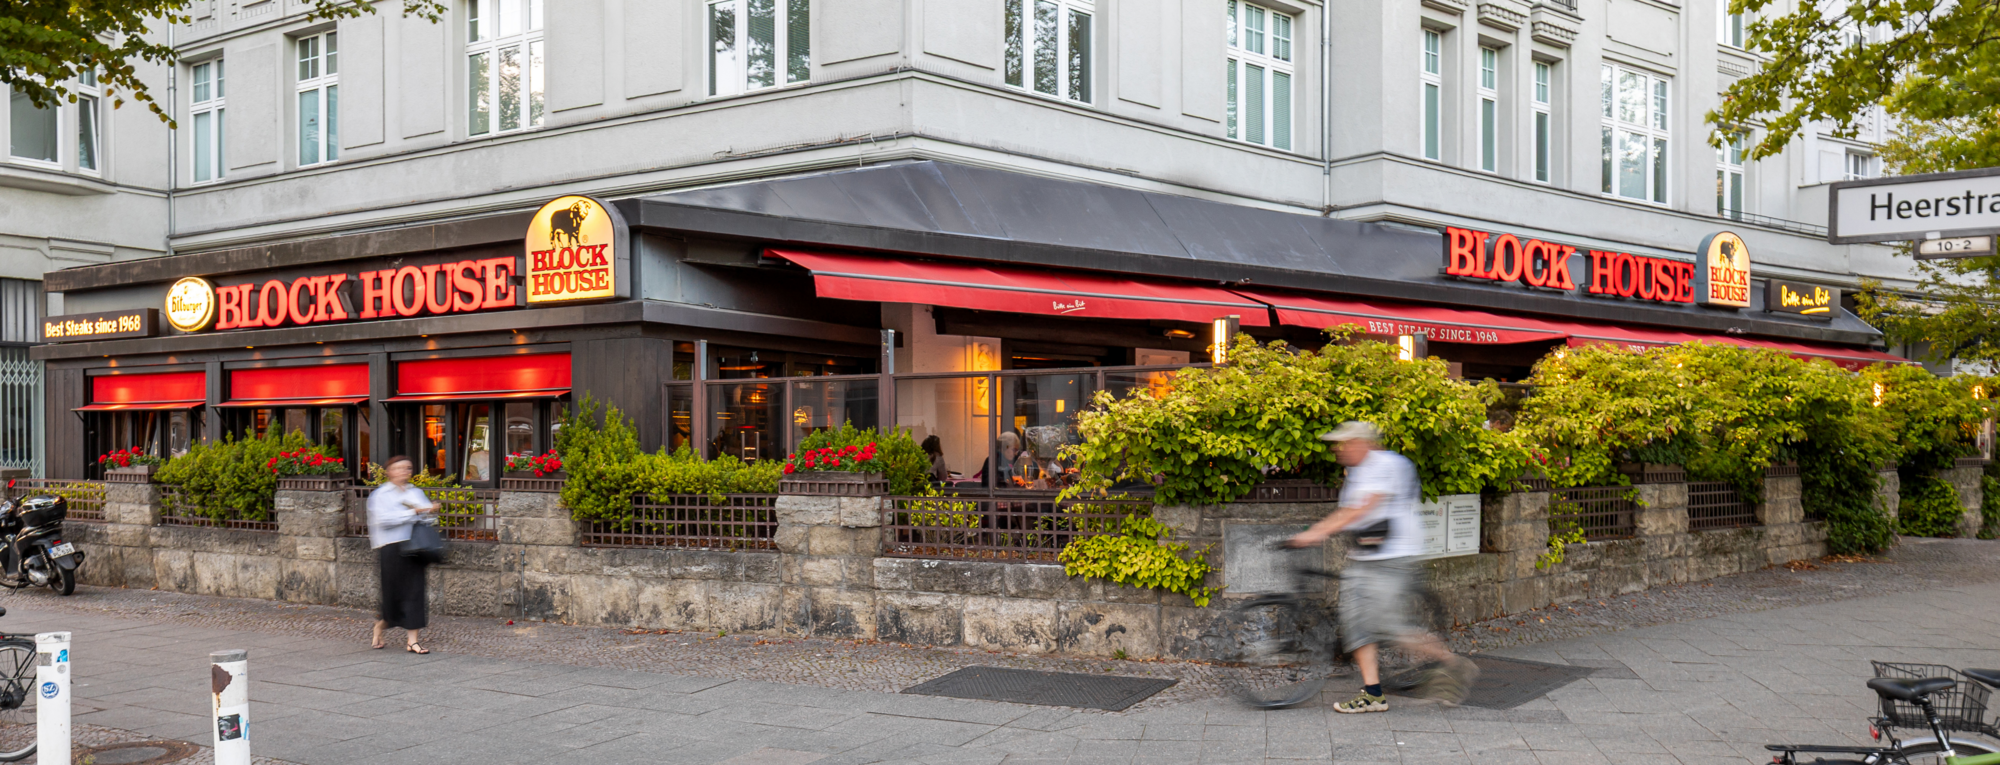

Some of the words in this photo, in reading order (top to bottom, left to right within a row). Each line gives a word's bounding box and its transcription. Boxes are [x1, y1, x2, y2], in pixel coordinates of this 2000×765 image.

[1870, 189, 2000, 221] Heerstra
[531, 243, 609, 272] BLOCK
[1446, 226, 1576, 291] BLOCK
[1589, 249, 1694, 303] HOUSE
[532, 267, 609, 295] HOUSE
[1710, 266, 1748, 286] BLOCK
[171, 295, 202, 313] Bitburger
[215, 273, 348, 330] BLOCK
[358, 255, 516, 319] HOUSE
[1710, 283, 1748, 302] HOUSE
[1781, 284, 1801, 308] Bitte
[1815, 286, 1830, 306] Bit
[45, 321, 65, 338] Best
[65, 319, 94, 336] Steaks
[94, 317, 118, 335] since
[118, 314, 141, 332] 1968
[1369, 320, 1394, 334] BEST
[1398, 324, 1436, 339] STEAKS
[1439, 328, 1472, 341] SINCE
[1475, 331, 1499, 343] 1968
